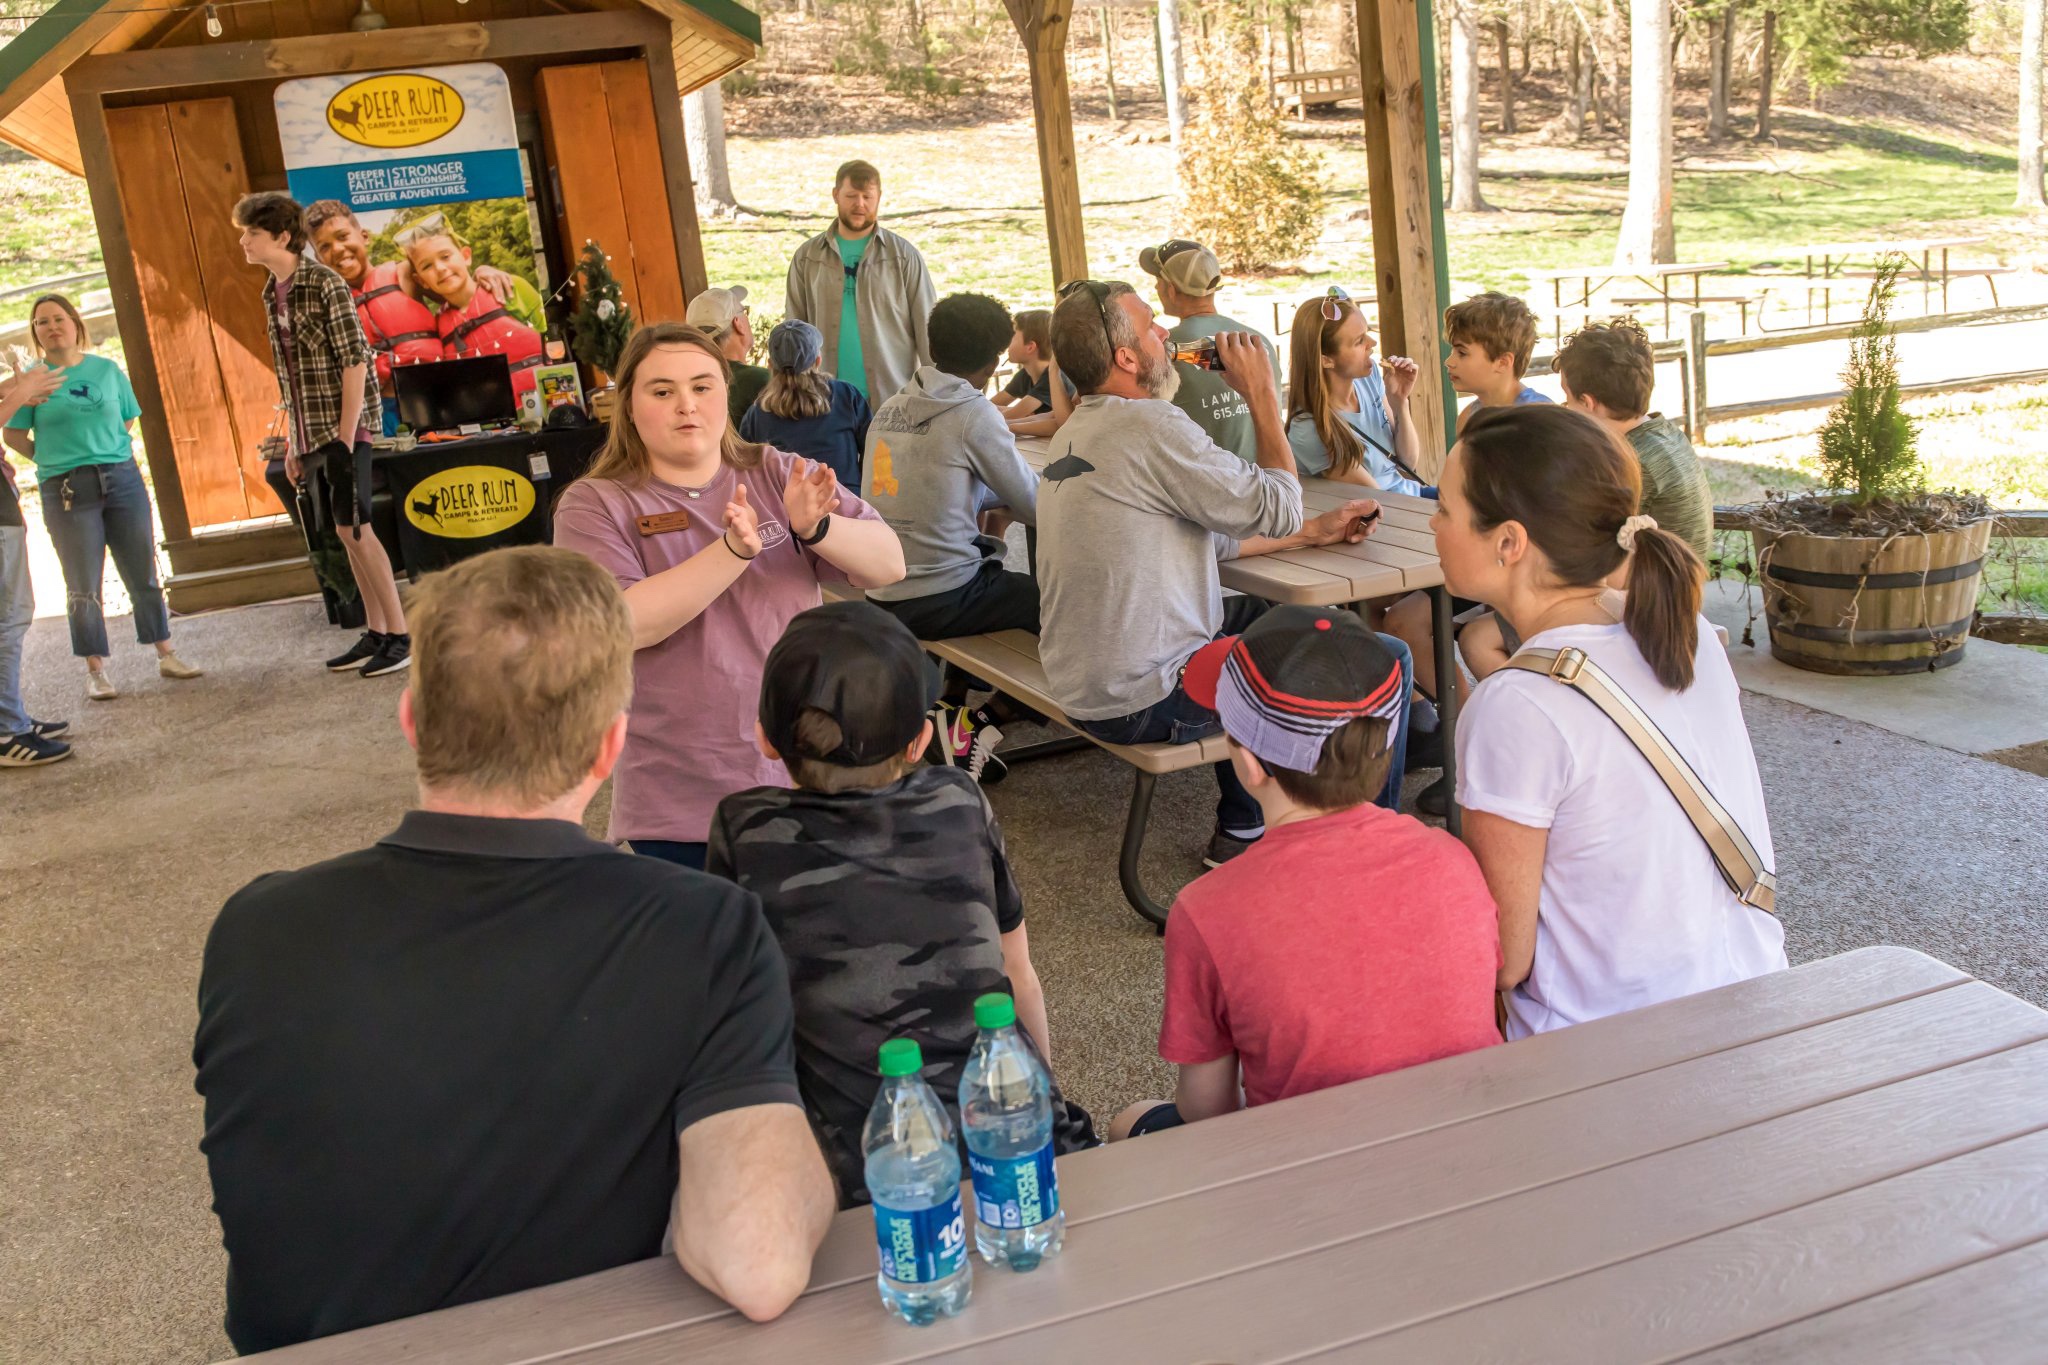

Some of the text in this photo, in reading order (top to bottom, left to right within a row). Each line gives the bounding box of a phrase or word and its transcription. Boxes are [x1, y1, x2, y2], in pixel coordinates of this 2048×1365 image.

[362, 86, 447, 120] DEER RUN
[367, 121, 397, 130] CAMPS
[407, 116, 449, 126] RETREATS
[347, 169, 385, 181] DEEPER
[392, 161, 464, 179] STRONGER
[393, 173, 467, 187] RELATIONSHIPS.
[349, 179, 388, 192] FAITH.
[351, 184, 469, 205] GREATER ADVENTURES.
[440, 479, 518, 511] DEER RUN
[444, 510, 471, 519] CAMPS
[481, 505, 518, 515] RETREATS
[1014, 1164, 1033, 1227] RECYCLE
[1026, 1161, 1042, 1223] ME AGAIN
[889, 1217, 908, 1280] RECYCLE
[900, 1218, 919, 1281] ME AGAIN
